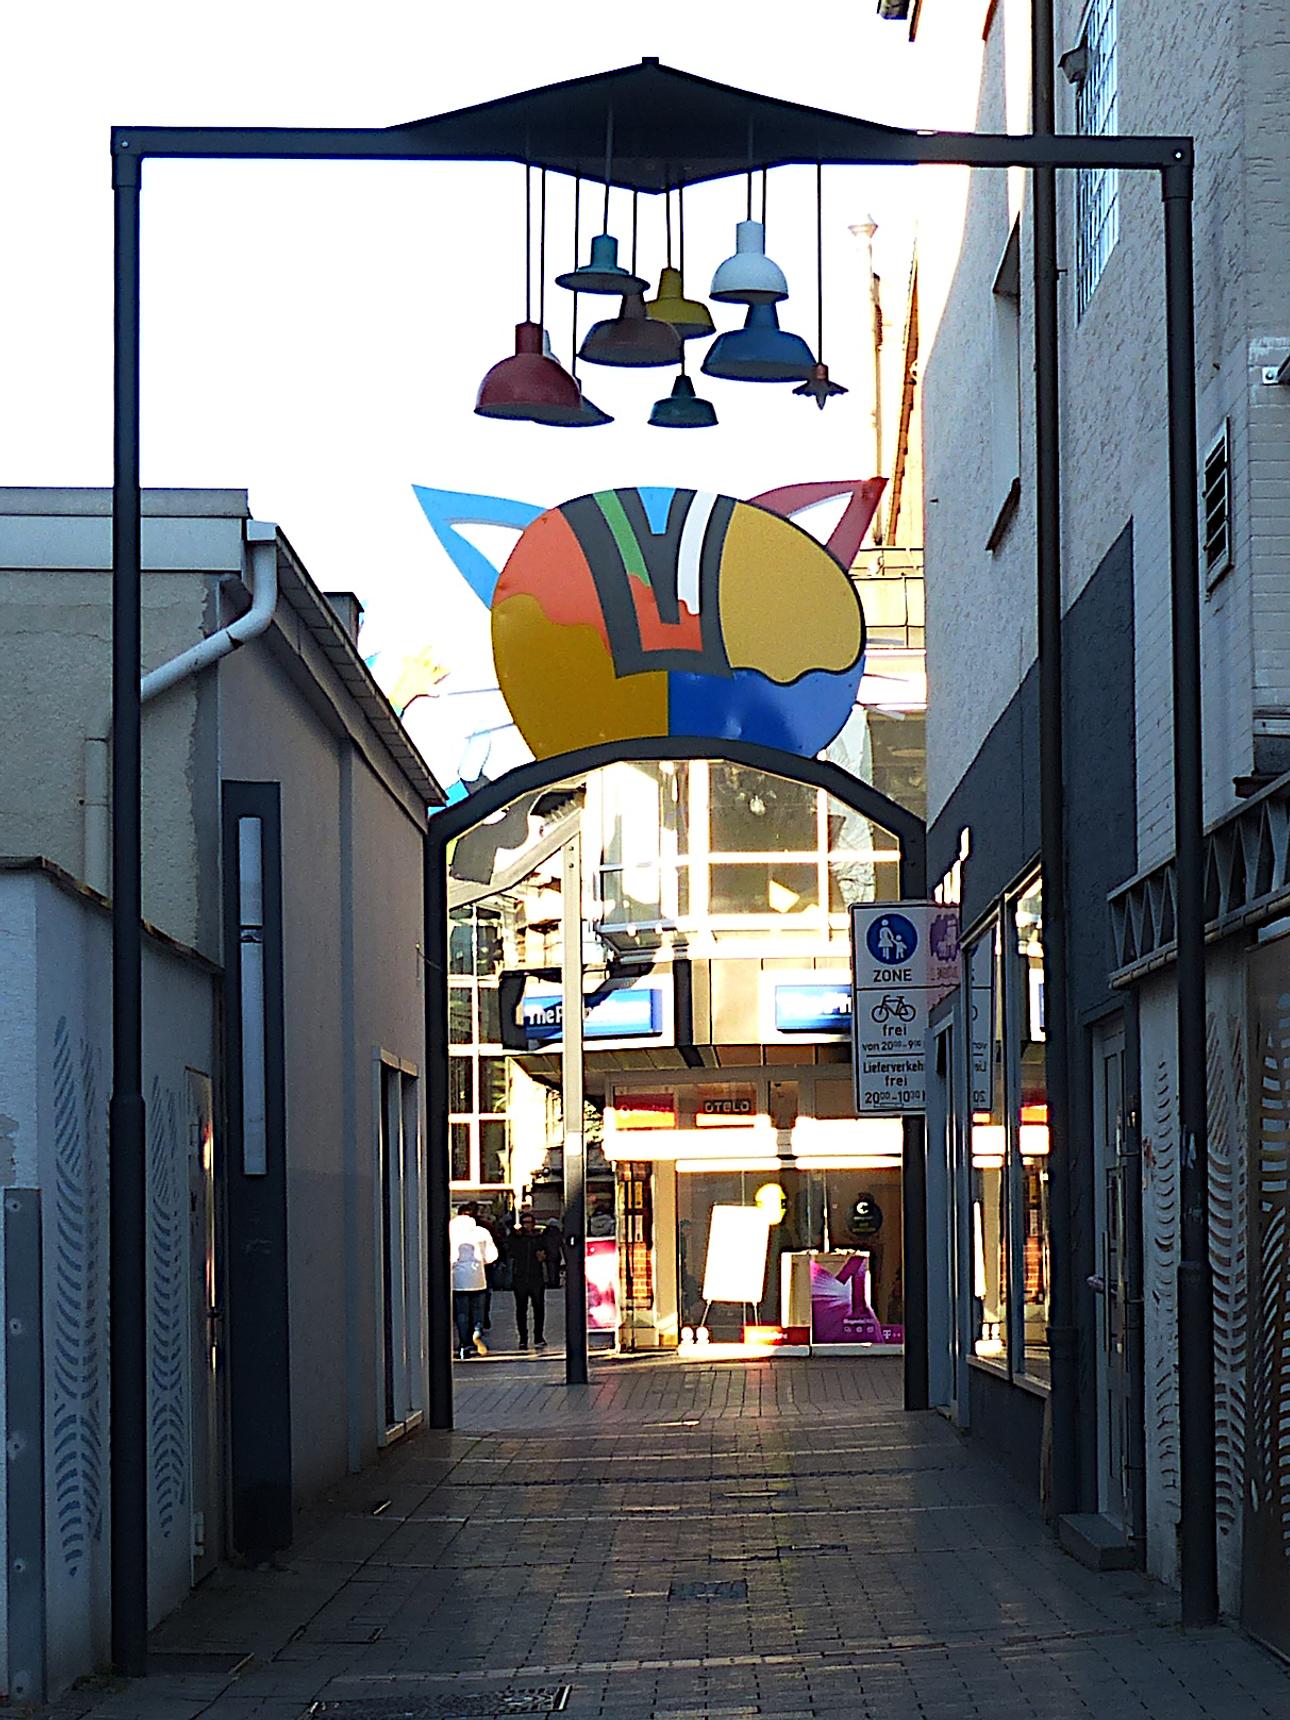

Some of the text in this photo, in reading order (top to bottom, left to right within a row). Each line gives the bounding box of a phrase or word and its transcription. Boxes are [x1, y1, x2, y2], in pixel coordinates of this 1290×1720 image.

[873, 969, 912, 982] ZONE
[883, 1024, 907, 1036] frei
[862, 1043, 880, 1051] von
[863, 1059, 924, 1074] Lieferverkeh
[885, 1075, 908, 1086] frei
